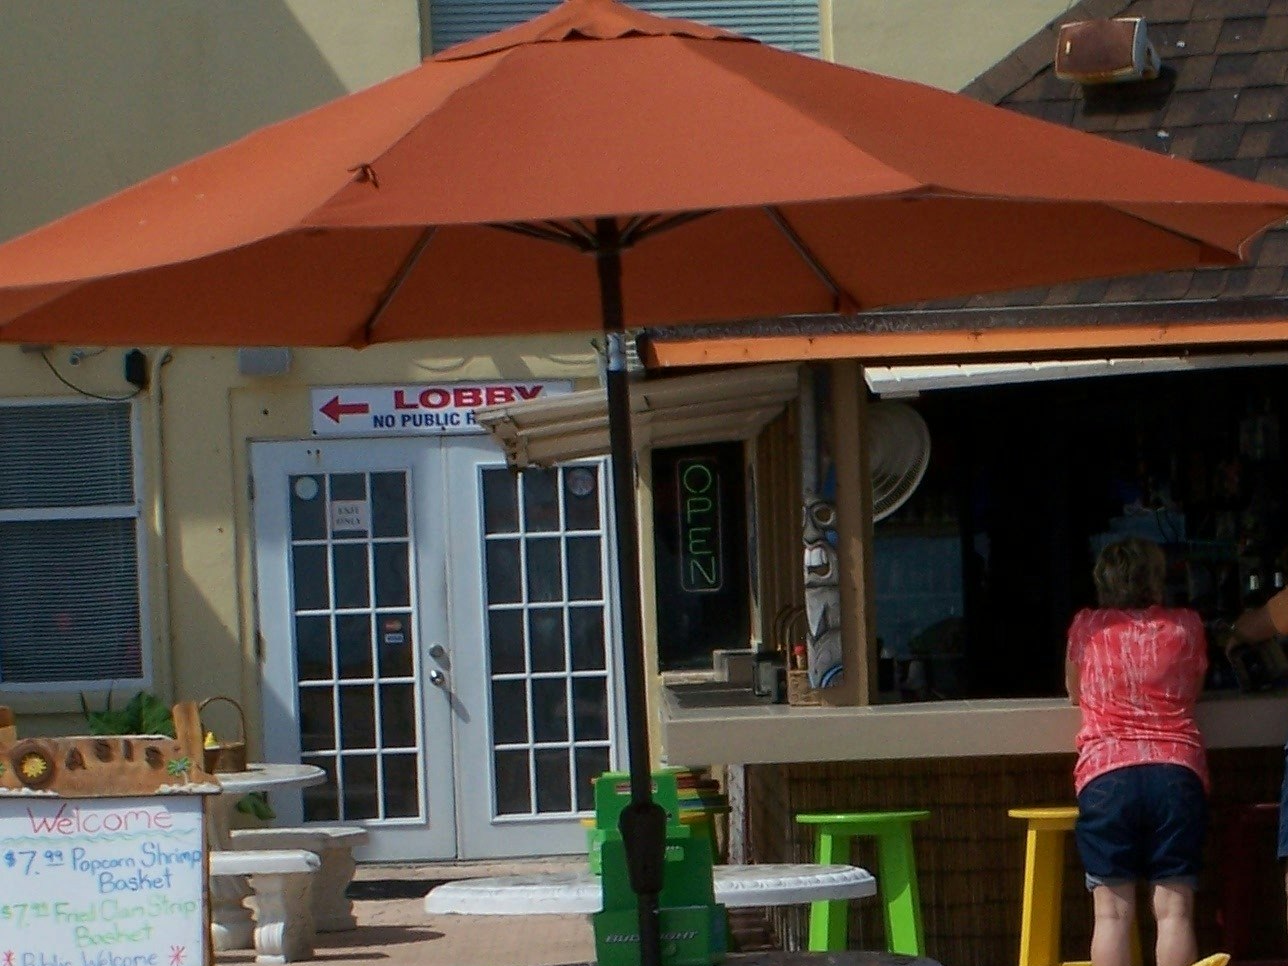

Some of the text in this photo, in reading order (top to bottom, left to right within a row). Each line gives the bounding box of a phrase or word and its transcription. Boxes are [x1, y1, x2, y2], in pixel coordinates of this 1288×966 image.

[393, 385, 544, 410] LOBBY
[372, 414, 396, 428] NO
[401, 411, 460, 427] PUBLIC
[682, 463, 717, 585] OPEN
[26, 803, 173, 835] Welcome
[71, 847, 136, 876] Popcorn
[141, 841, 201, 869] Shrimp
[98, 868, 173, 893] Basket
[74, 923, 154, 948] Basket
